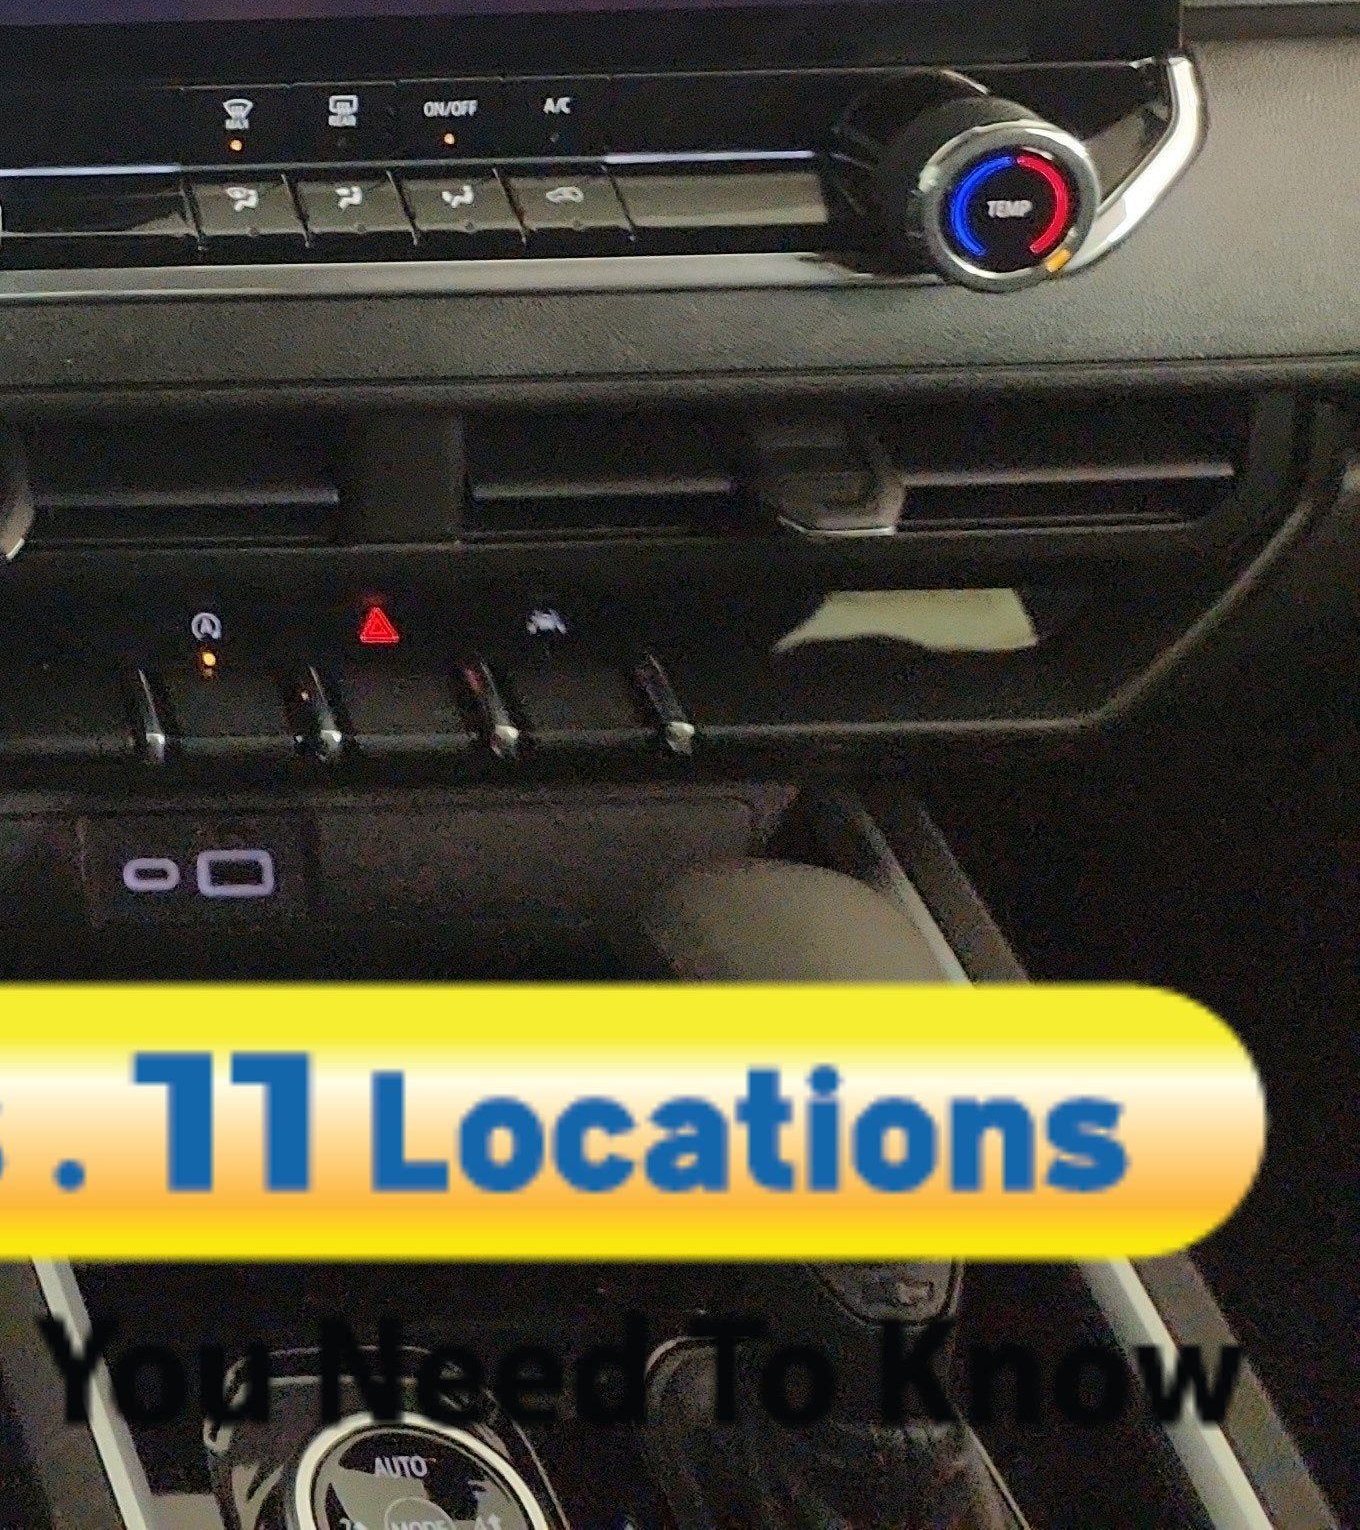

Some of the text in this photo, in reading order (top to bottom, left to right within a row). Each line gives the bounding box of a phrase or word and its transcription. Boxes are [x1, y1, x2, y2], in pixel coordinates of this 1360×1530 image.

[423, 100, 479, 117] ON/OFF
[542, 97, 573, 115] A/C
[986, 200, 1032, 219] TEMP
[374, 1455, 428, 1478] AUTO
